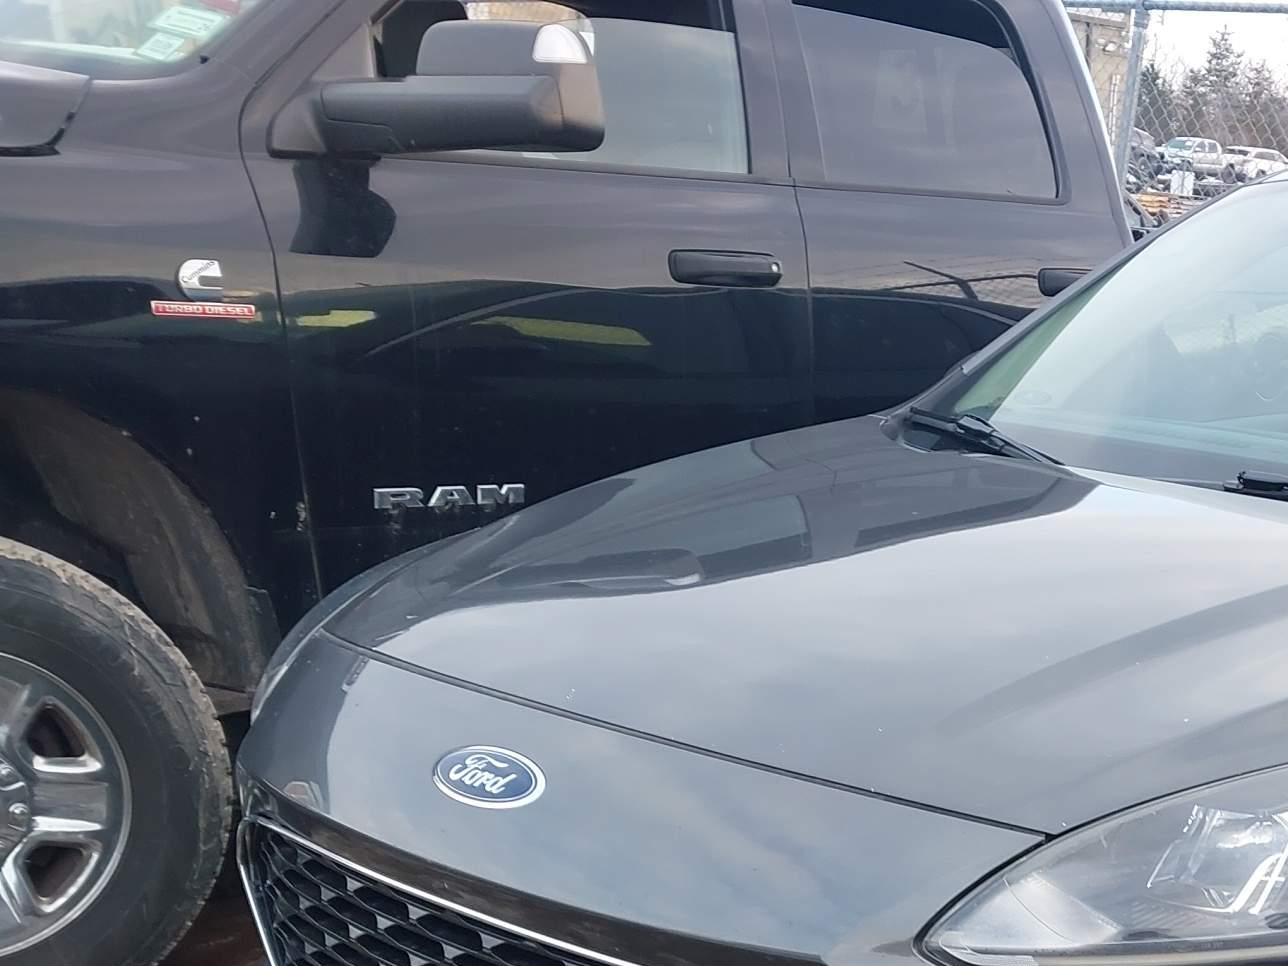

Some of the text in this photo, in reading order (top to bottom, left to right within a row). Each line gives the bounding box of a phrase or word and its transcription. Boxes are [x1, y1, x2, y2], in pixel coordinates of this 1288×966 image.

[204, 306, 251, 315] DIESEL
[373, 484, 525, 509] RAM
[449, 754, 517, 794] Ford
